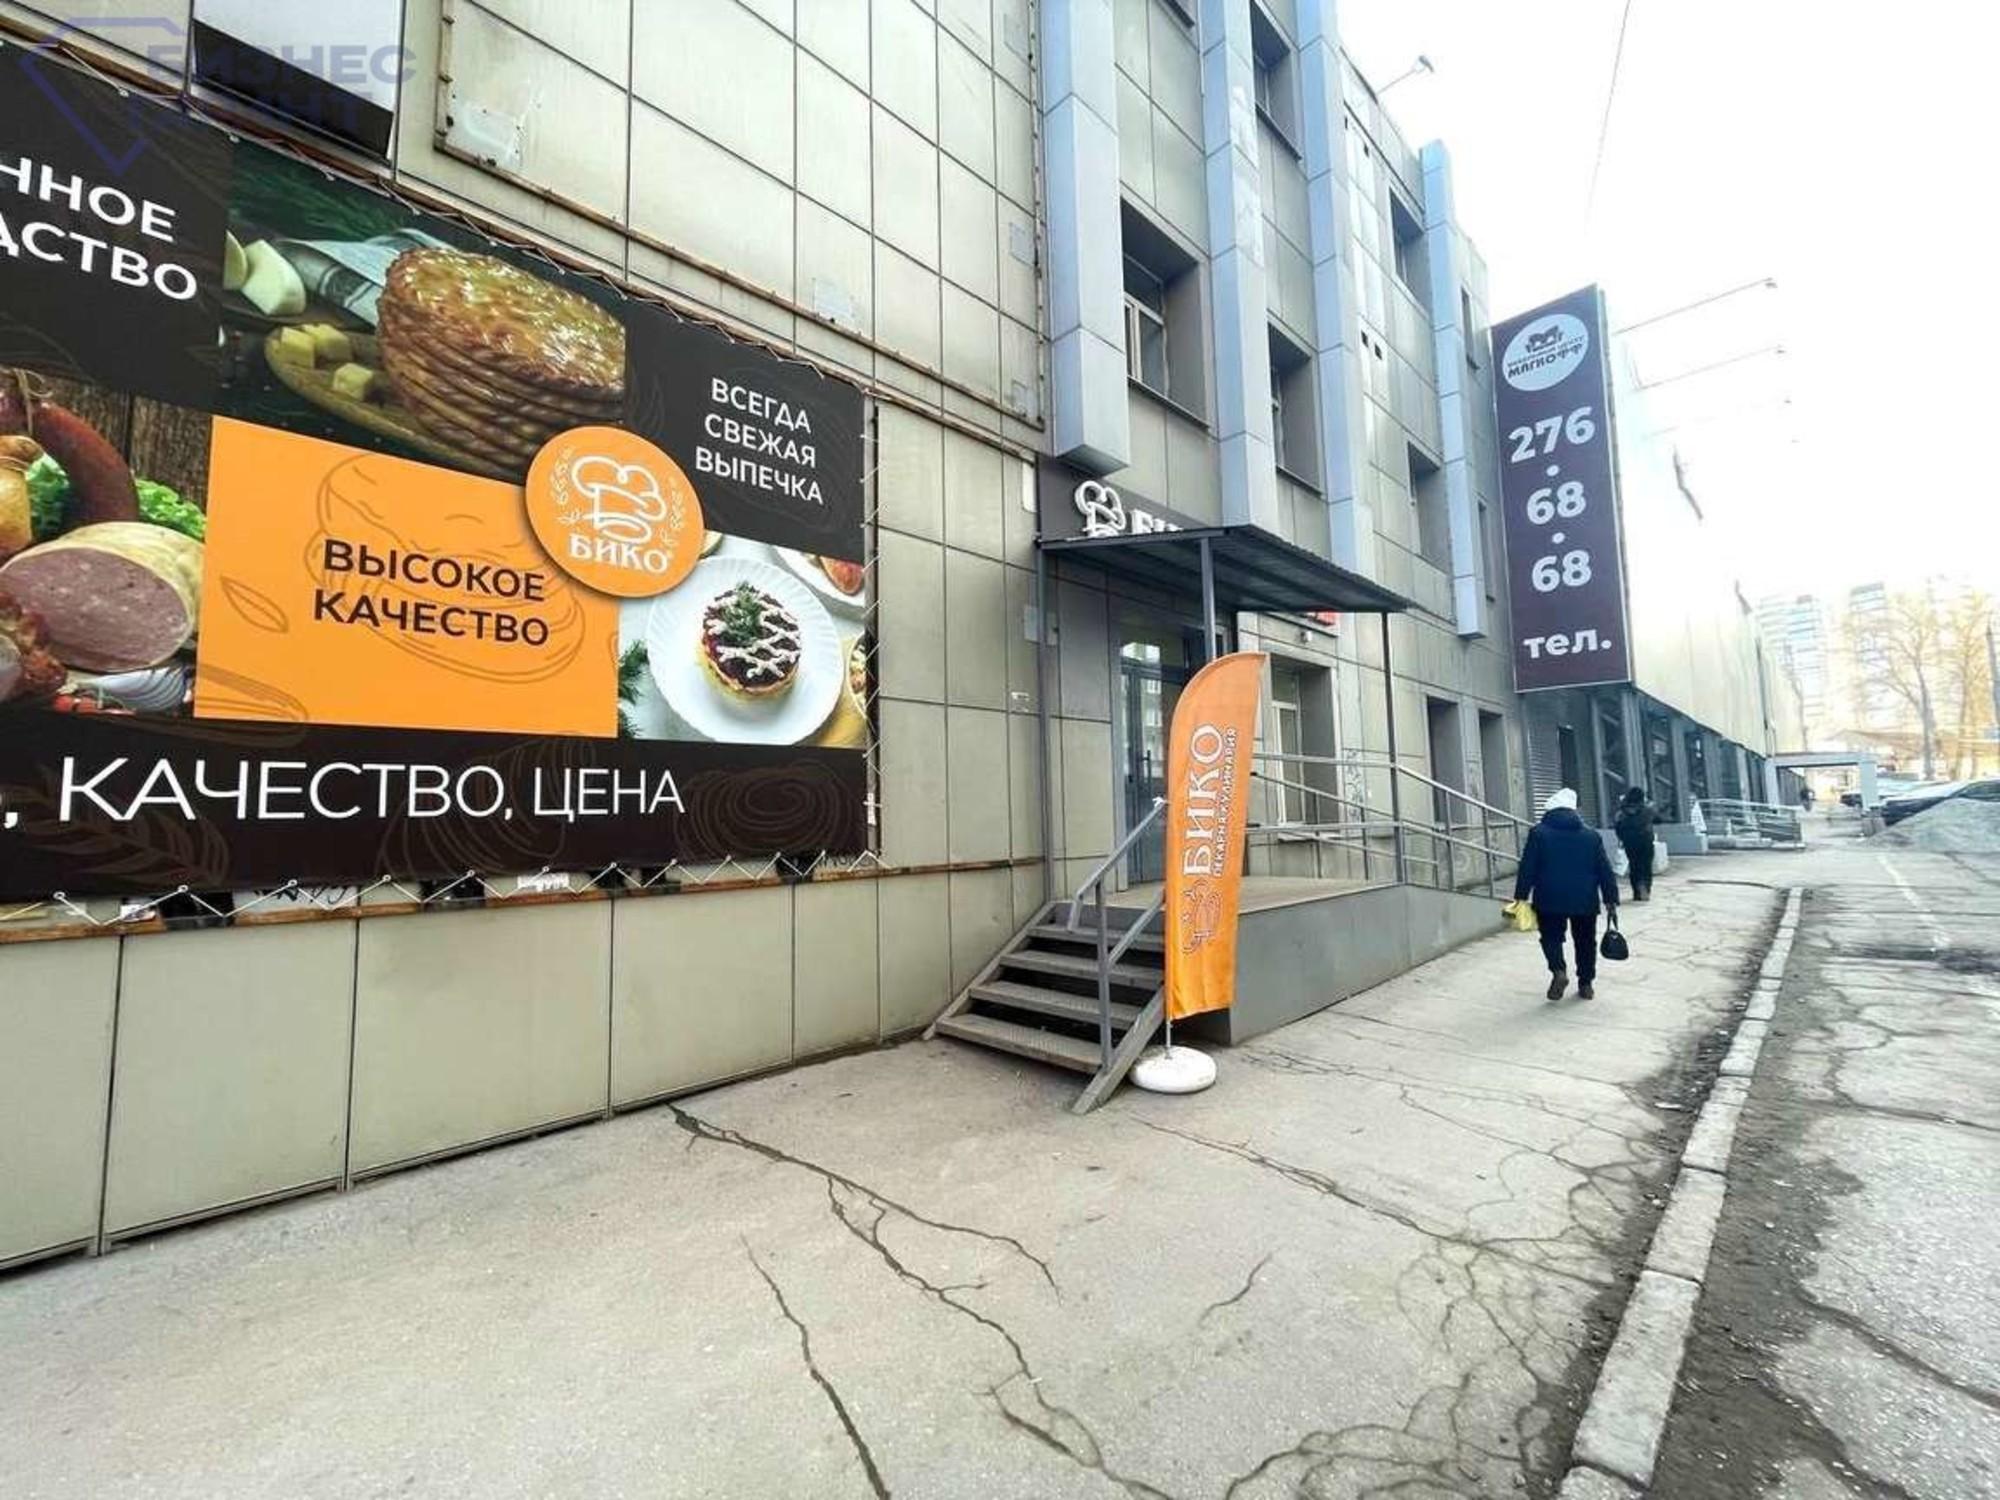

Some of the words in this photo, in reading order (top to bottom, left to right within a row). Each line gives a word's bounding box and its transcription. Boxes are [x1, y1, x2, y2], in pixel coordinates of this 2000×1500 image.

[711, 378, 812, 433] ВСЕГДА
[704, 414, 816, 468] СВЕЖАЯ
[1508, 406, 1596, 463] 276
[696, 446, 823, 505] ВЫПЕЧКА
[1527, 481, 1587, 525] 68
[324, 539, 545, 601] ВЫСОКОЕ
[569, 532, 668, 574] БИКО
[1531, 550, 1592, 592] 68
[314, 589, 548, 647] КАЧЕСТВО
[1524, 628, 1612, 659] тел.
[60, 757, 513, 820] КАЧЕСТВО,
[534, 769, 685, 822] ЦЕНА
[1184, 724, 1223, 875] БИКО
